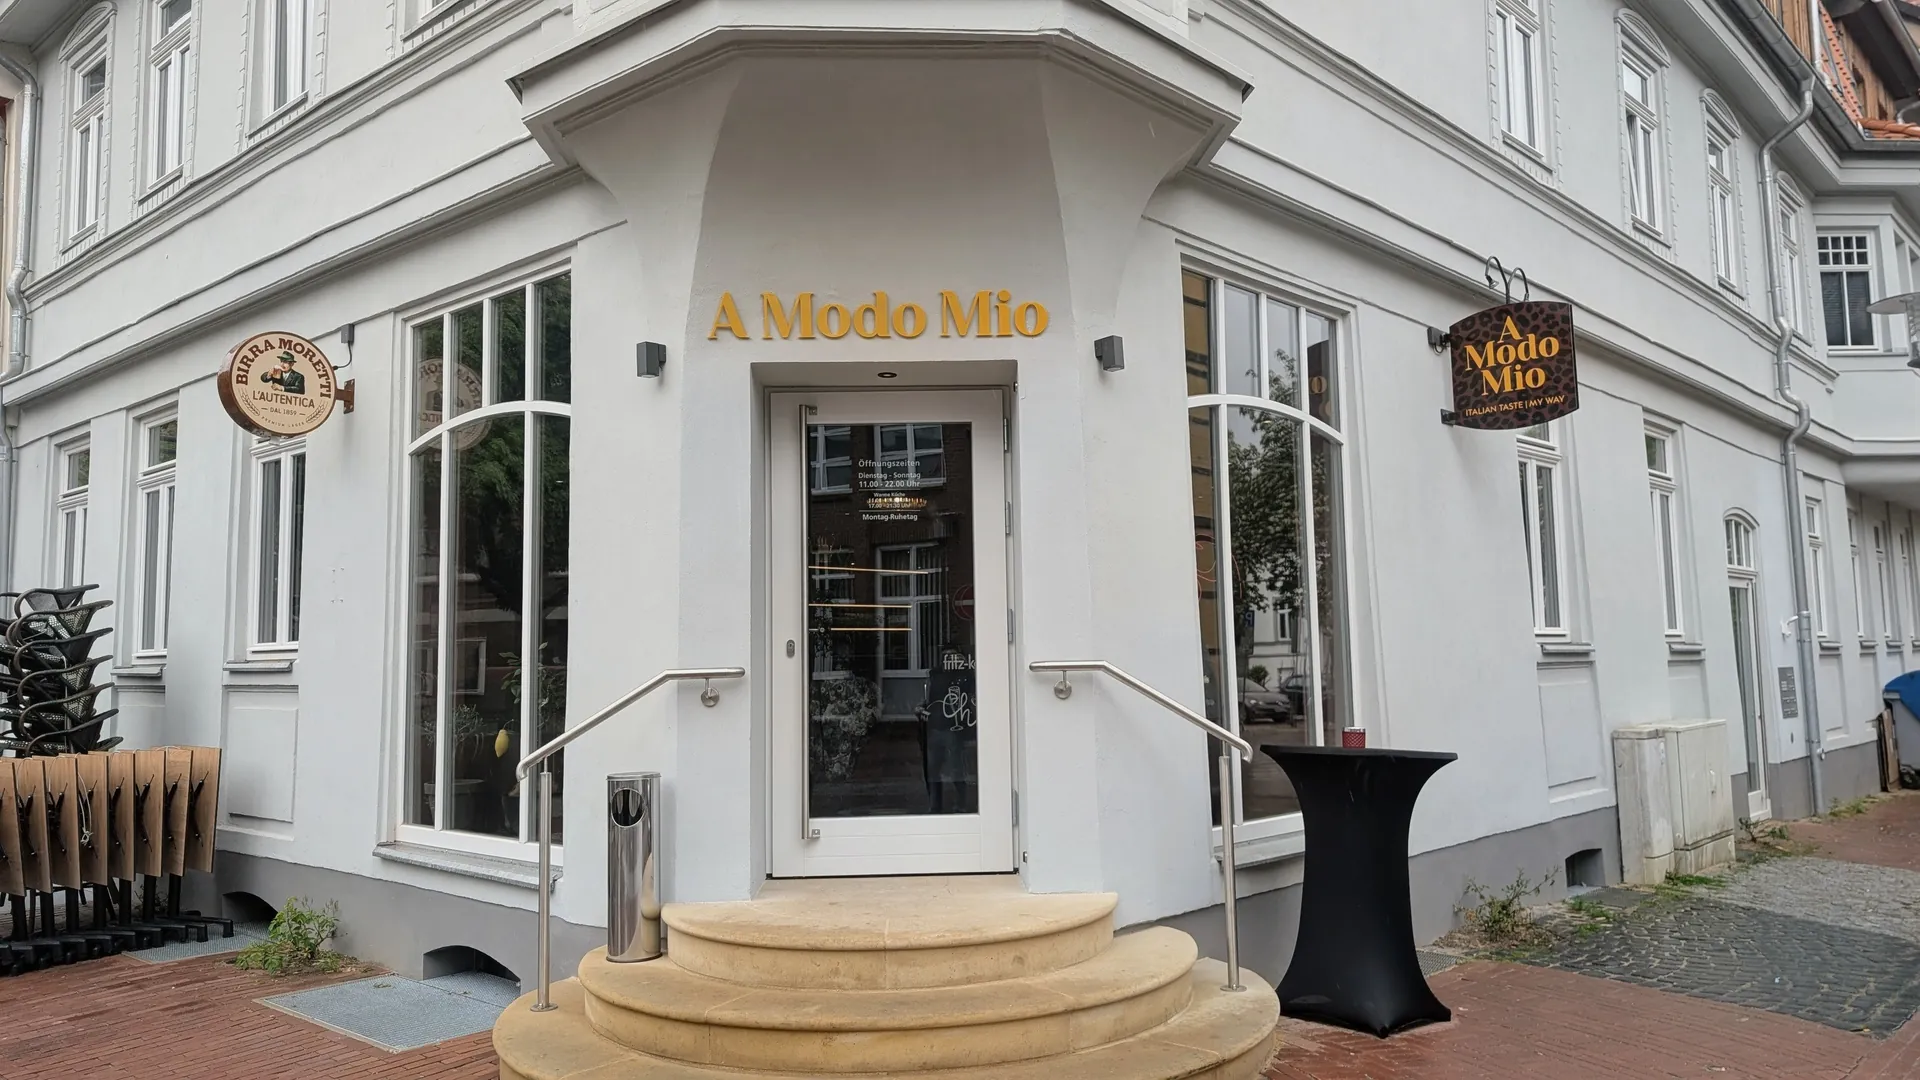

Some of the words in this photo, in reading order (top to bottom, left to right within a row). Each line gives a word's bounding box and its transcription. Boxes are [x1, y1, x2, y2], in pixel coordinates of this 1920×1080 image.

[707, 291, 750, 340] A
[760, 289, 928, 340] Modo
[939, 289, 1049, 338] Mio
[1497, 315, 1523, 344] A
[1464, 333, 1560, 371] Modo
[235, 339, 276, 386] BIRRA
[278, 337, 332, 399] MORETTI
[1481, 364, 1546, 396] Mio
[252, 390, 315, 408] L'AUTENTICA
[1465, 405, 1497, 417] ITALIAN
[1499, 400, 1524, 411] TASTE
[1529, 398, 1543, 408] MY
[1545, 395, 1565, 405] WAY
[858, 472, 888, 480] Dienstag
[893, 472, 921, 480] Sonntag
[859, 459, 920, 468] Öffnungszeiten
[859, 480, 879, 488] 11.00
[884, 480, 905, 488] 22.00
[906, 480, 920, 488] Uhr
